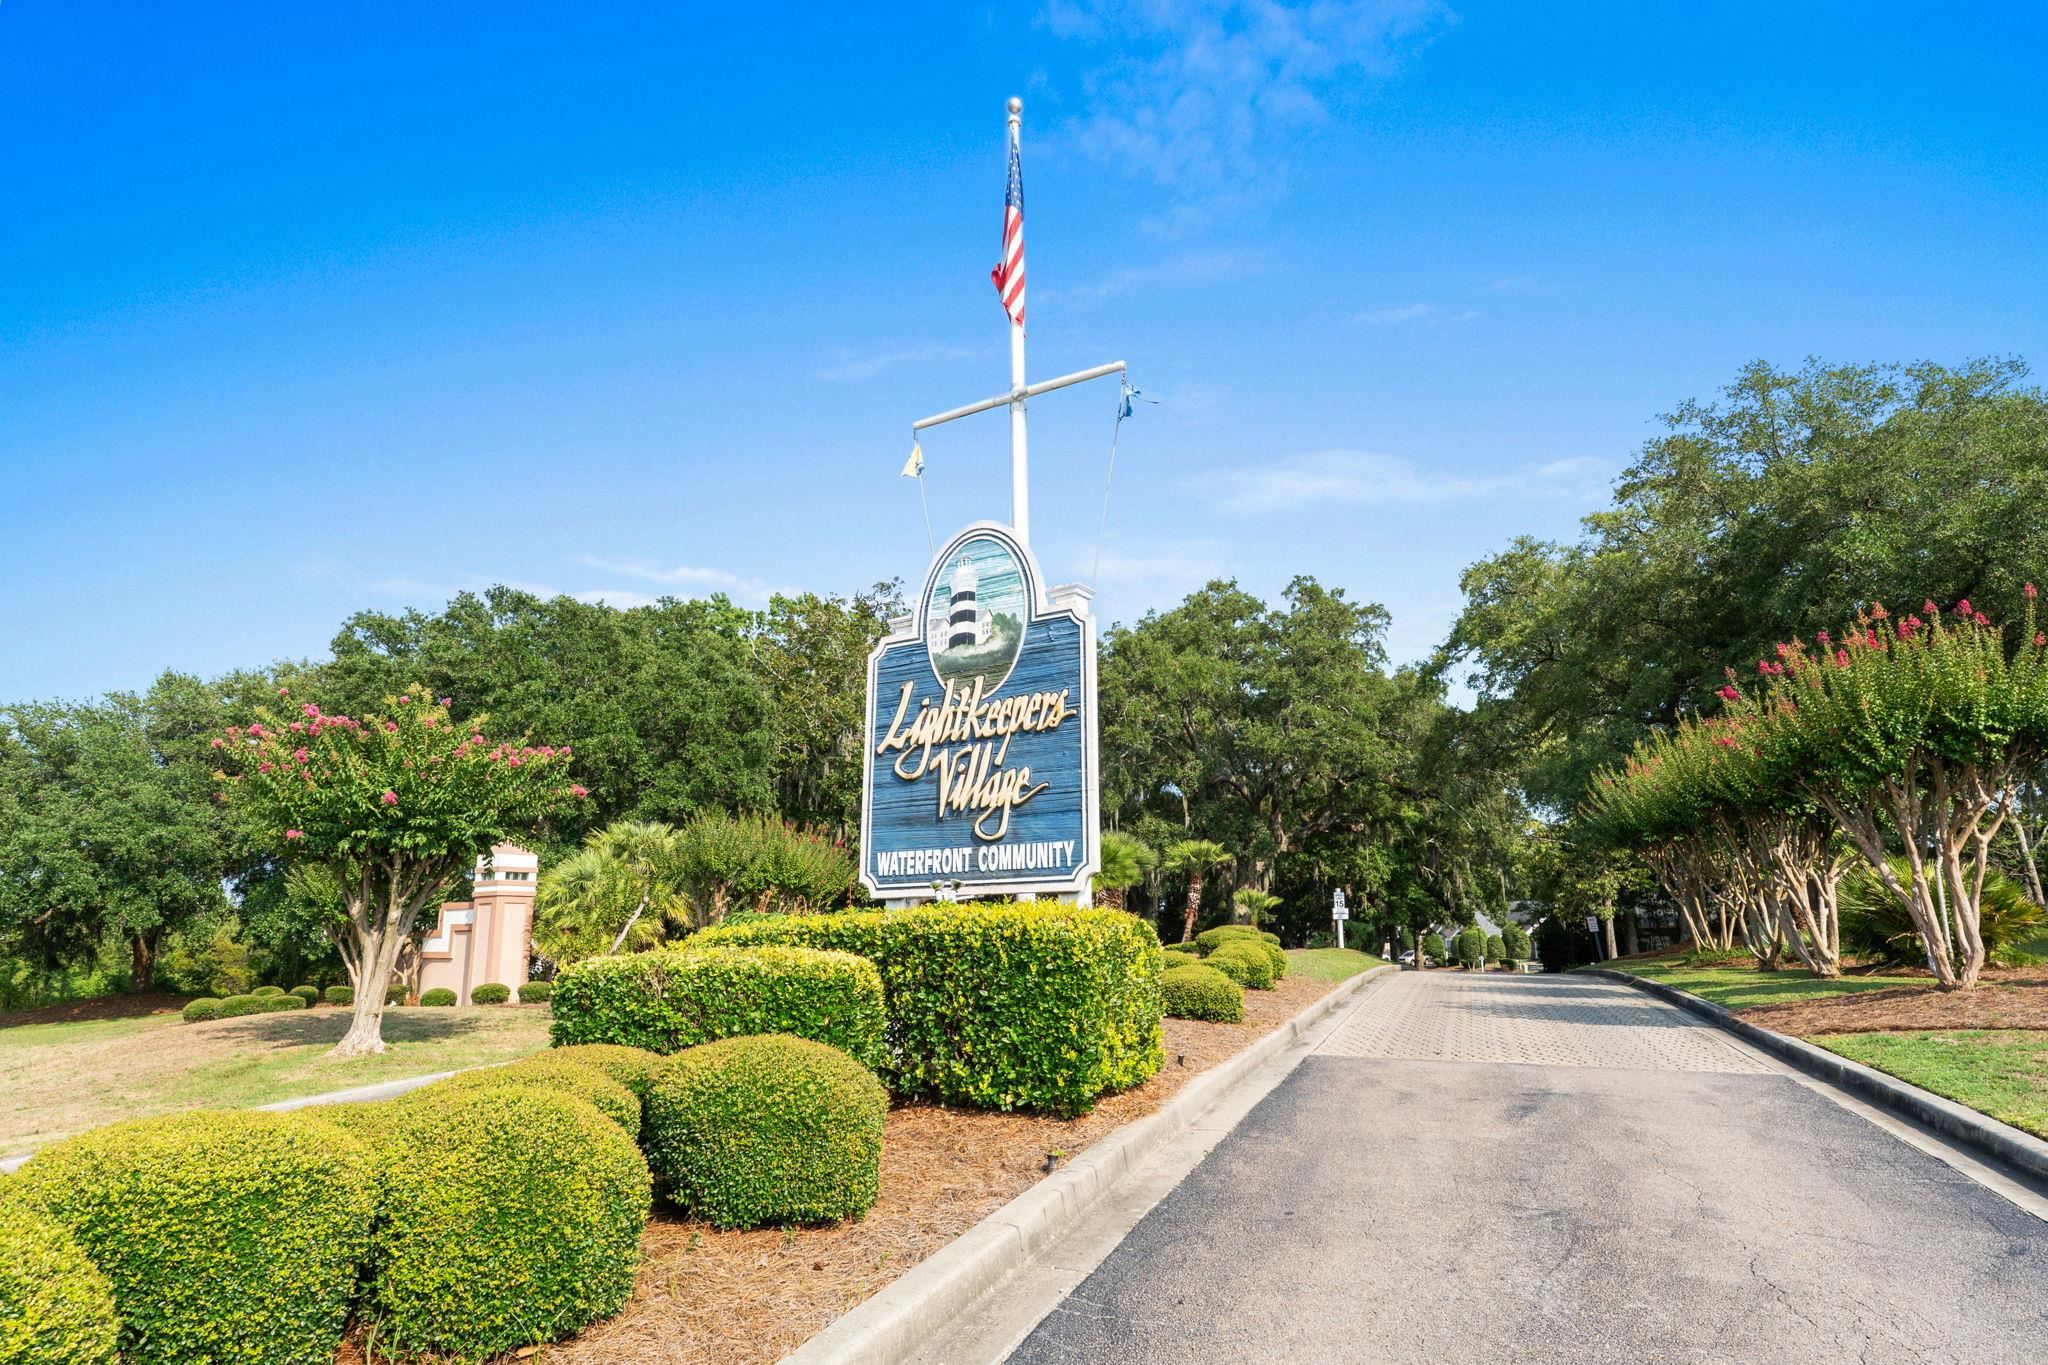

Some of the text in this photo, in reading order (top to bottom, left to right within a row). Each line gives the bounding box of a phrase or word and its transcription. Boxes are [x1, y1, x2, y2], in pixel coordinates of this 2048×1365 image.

[877, 675, 1076, 779] Lightkeepers
[929, 741, 1049, 840] Village
[877, 841, 1075, 876] WATERFRONT COMMUNITY
[1336, 900, 1344, 908] 15
